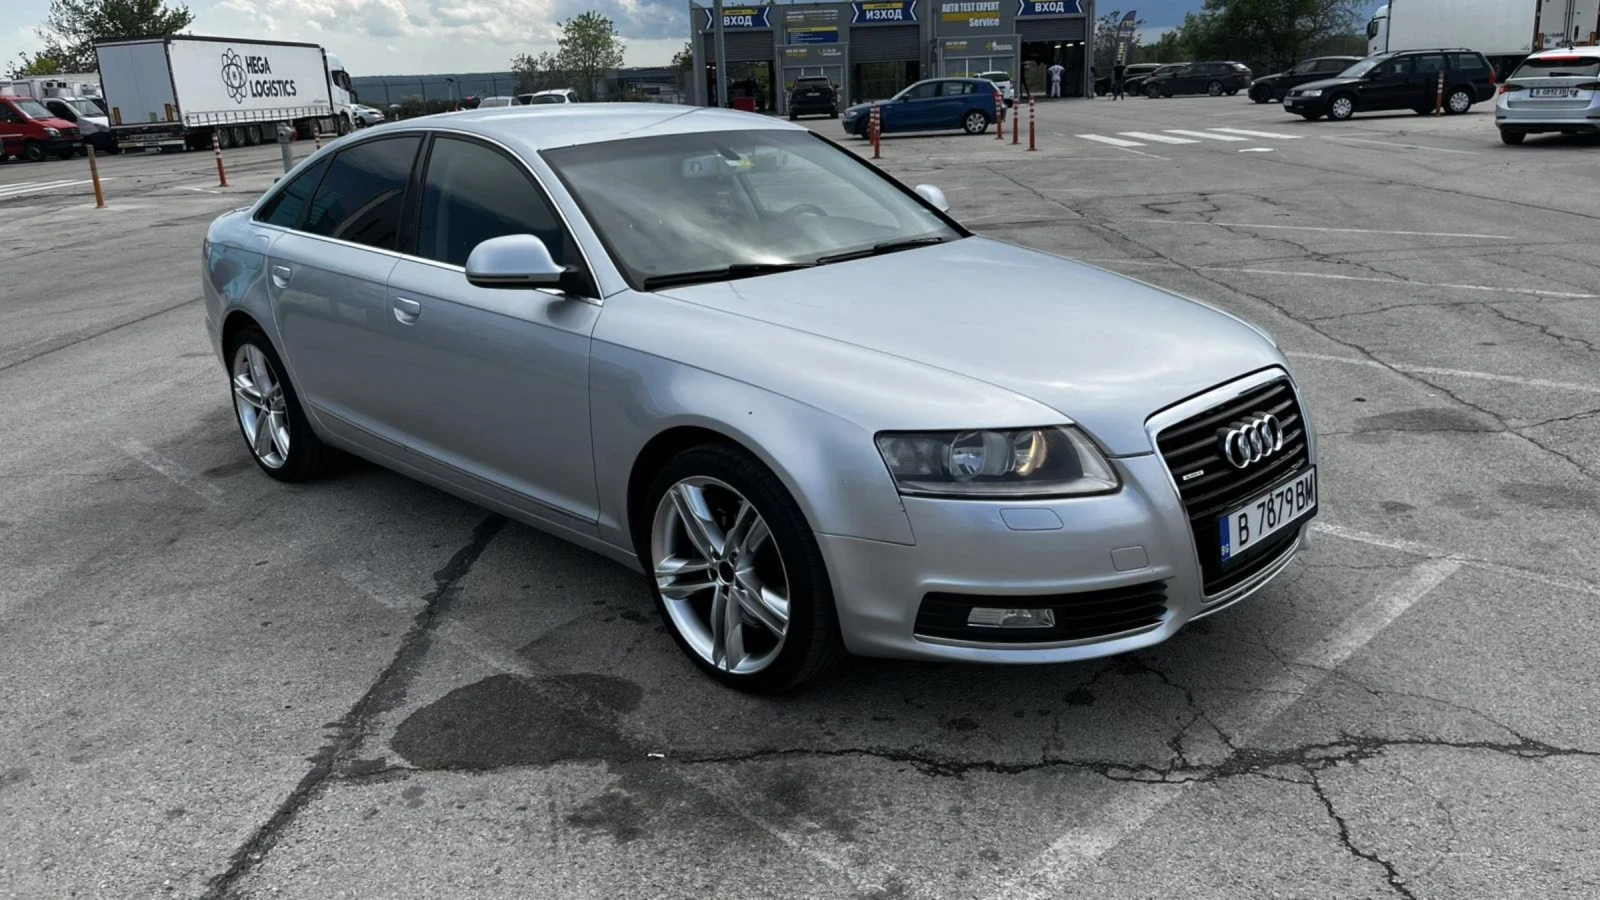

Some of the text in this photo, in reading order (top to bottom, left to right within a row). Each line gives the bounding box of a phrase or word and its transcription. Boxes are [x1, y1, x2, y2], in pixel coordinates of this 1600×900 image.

[942, 1, 1000, 13] AUTO TEST EXPERT
[1035, 2, 1065, 13] ВХОД
[723, 15, 752, 26] ВХОД
[866, 9, 903, 20] ИЗХОД
[969, 17, 1000, 27] Service
[245, 56, 272, 74] HEGA
[249, 80, 297, 98] LOGISTICS
[1238, 473, 1314, 547] B 7879 BM
[1221, 543, 1230, 556] BG
